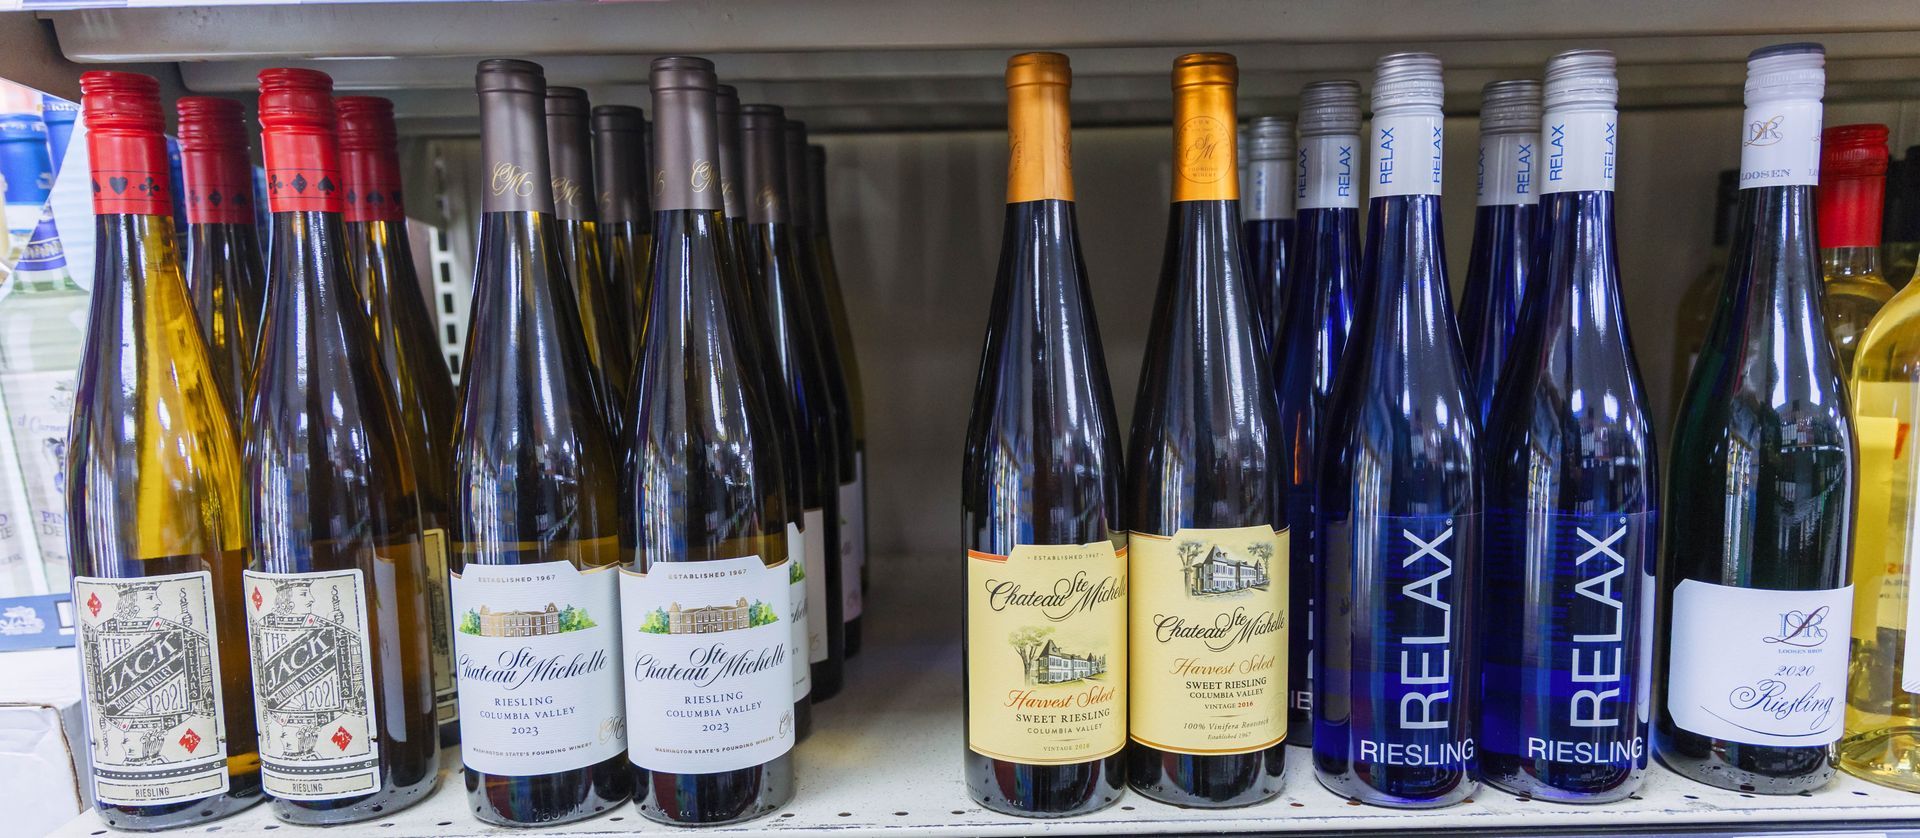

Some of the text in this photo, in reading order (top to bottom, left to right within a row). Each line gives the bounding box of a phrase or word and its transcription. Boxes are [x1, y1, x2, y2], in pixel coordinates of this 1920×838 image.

[1380, 127, 1394, 185] RELAX
[1433, 126, 1441, 183] RELAX
[1550, 124, 1564, 181] RELAX
[1604, 123, 1615, 178] RELAX
[1299, 148, 1307, 198] RELAX
[1338, 146, 1351, 196] RELAX
[1517, 143, 1531, 194] RELAX
[668, 569, 747, 580] ESTABLISHED 1967
[1054, 570, 1089, 597] Ste
[985, 578, 1068, 611] Chateau
[1153, 610, 1285, 648] Chateau Michelle
[1215, 606, 1248, 631] Ste
[103, 638, 132, 663] THE
[264, 632, 288, 657] THE
[689, 642, 729, 667] Ste
[106, 635, 178, 697] JACK
[266, 629, 330, 690] JACK
[458, 649, 607, 690] Chateau Michelle
[498, 646, 537, 670] Ste
[635, 651, 709, 682] Chateau
[1169, 655, 1276, 677] Harvest Select
[1774, 665, 1815, 676] 2020
[115, 666, 174, 709] COLUMBIA VALLEY
[299, 662, 325, 689] VALLEY
[1186, 676, 1267, 690] SWEET RIESLING
[155, 679, 185, 713] 2021
[308, 677, 338, 710] 2021
[494, 695, 554, 706] RIESLING
[684, 691, 744, 704] RIESLING
[1004, 686, 1115, 710] Harvest Select
[1190, 688, 1264, 699] COLUMBIA VALLEY
[1729, 679, 1835, 730] Riesling
[480, 706, 576, 720] COLUMBIA VALLEY
[666, 701, 762, 718] COLUMBIA VALLEY
[1016, 708, 1110, 724] SWEET RIESLING
[511, 726, 539, 736] 2023
[702, 722, 730, 733] 2023
[1076, 723, 1102, 732] VALLEY
[1184, 722, 1206, 730] 100%
[1209, 722, 1239, 732] Vinifera
[532, 747, 566, 756] FOUNDING
[568, 742, 592, 751] WINERY
[722, 742, 753, 752] FOUNDING
[1360, 738, 1474, 765] RIESLING
[1528, 736, 1643, 764] RIESLING
[135, 786, 170, 798] RIESLING
[292, 782, 323, 793] RIESLING
